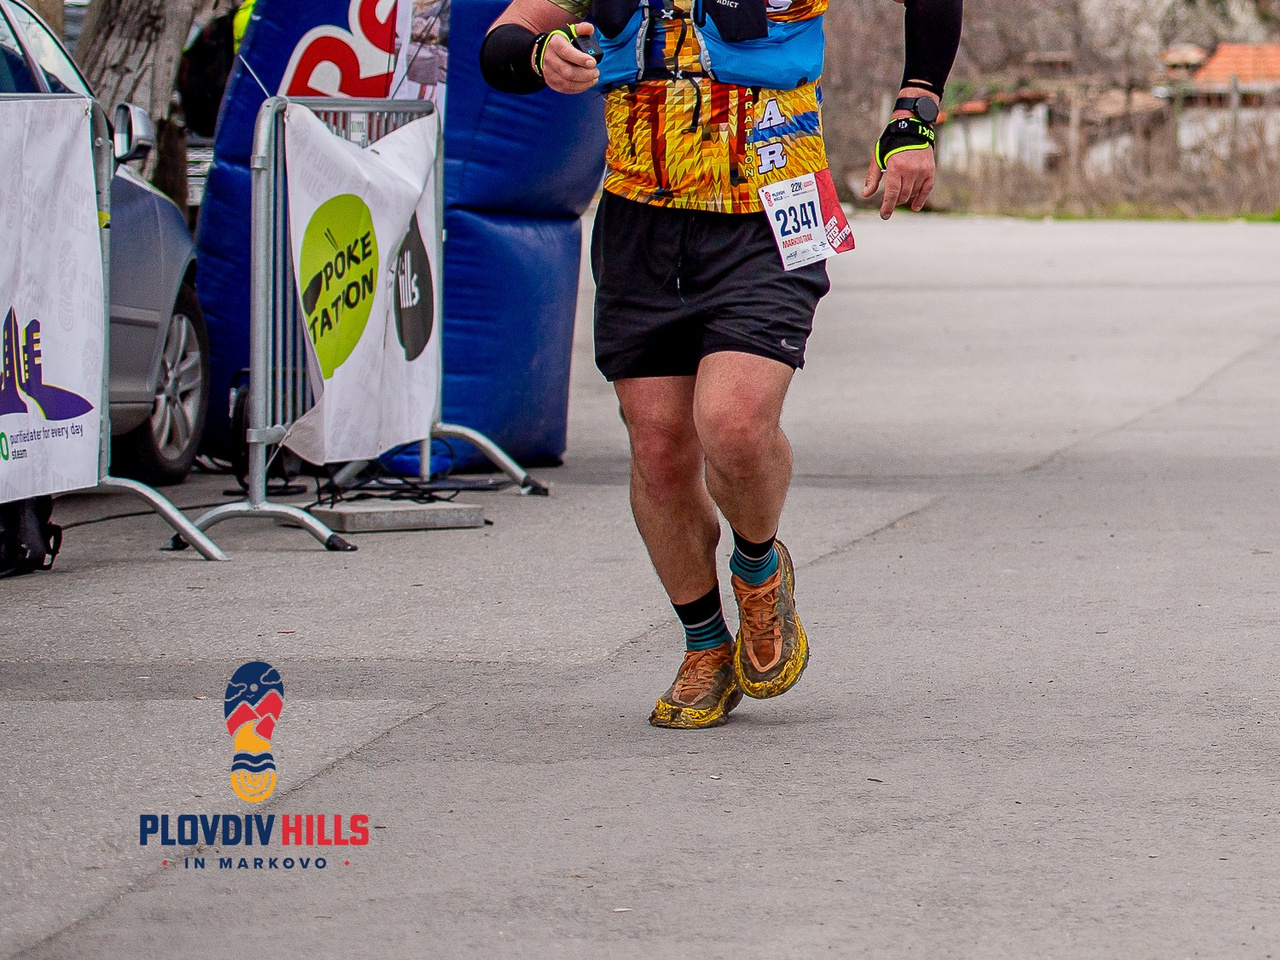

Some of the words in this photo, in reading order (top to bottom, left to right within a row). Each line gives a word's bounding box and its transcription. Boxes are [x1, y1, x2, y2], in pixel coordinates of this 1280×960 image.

[774, 200, 819, 237] 2341
[323, 230, 372, 291] POKE
[51, 426, 69, 439] every
[70, 422, 83, 437] day
[11, 448, 28, 460] steam
